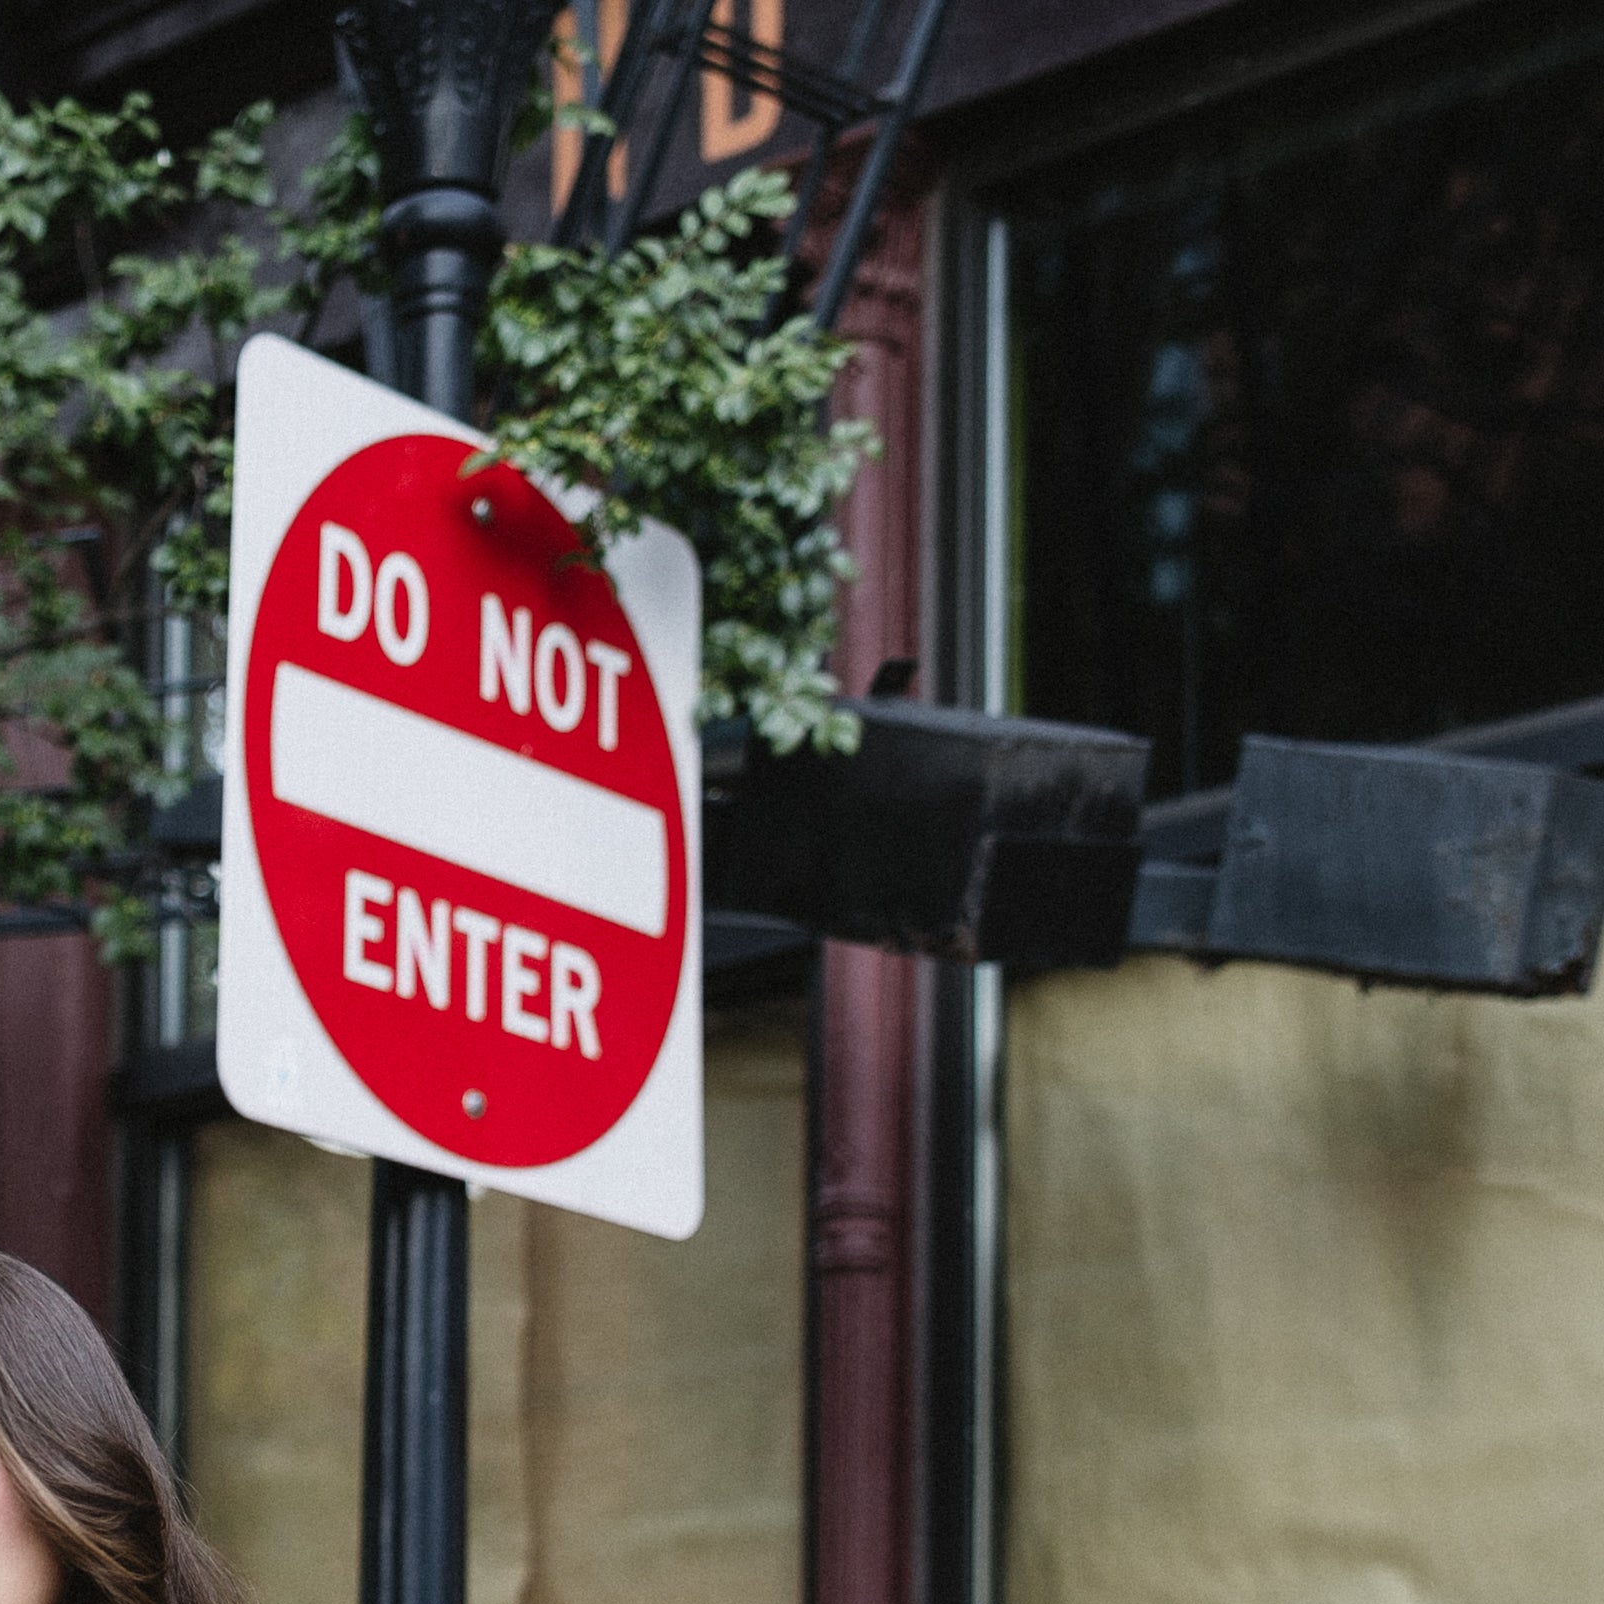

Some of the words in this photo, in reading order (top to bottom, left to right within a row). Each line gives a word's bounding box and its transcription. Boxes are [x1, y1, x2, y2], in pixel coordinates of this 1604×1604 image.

[317, 520, 430, 667] DO
[479, 593, 631, 752] NOT
[342, 868, 602, 1060] ENTER
